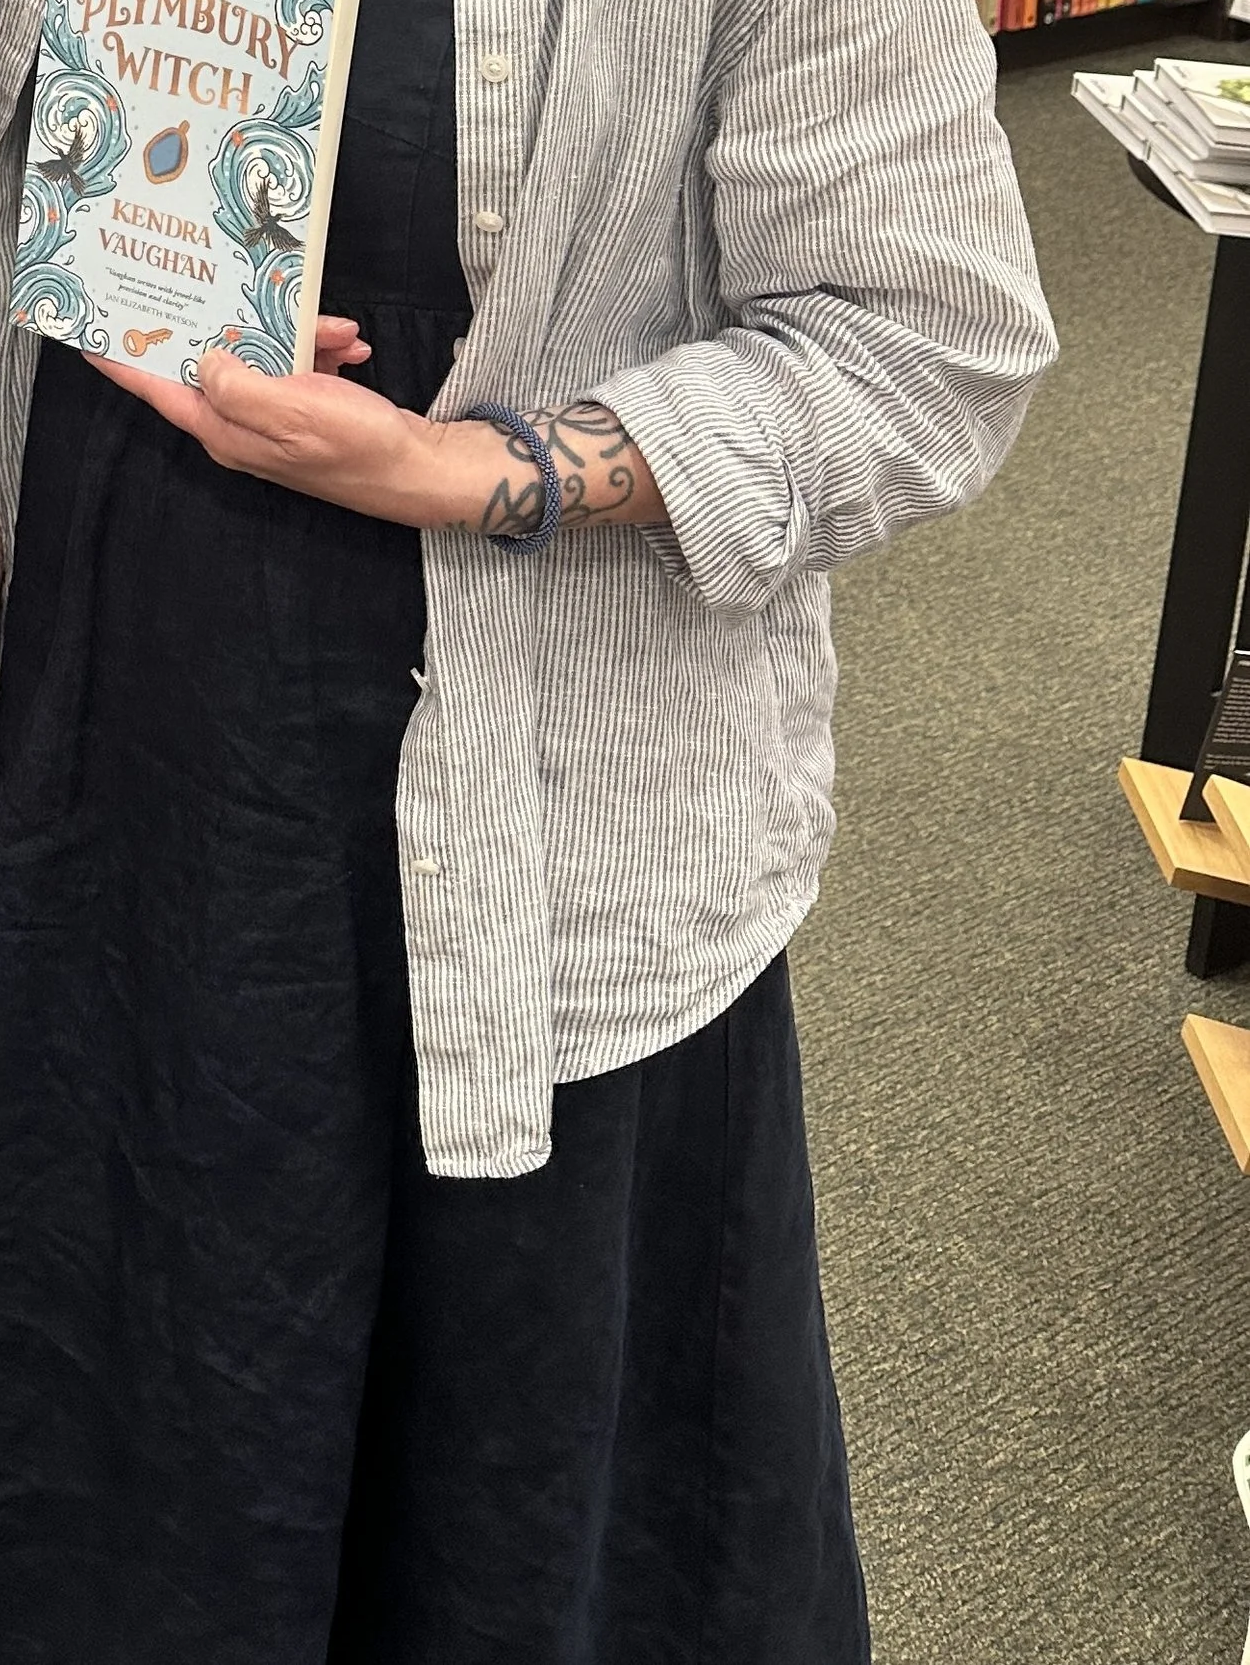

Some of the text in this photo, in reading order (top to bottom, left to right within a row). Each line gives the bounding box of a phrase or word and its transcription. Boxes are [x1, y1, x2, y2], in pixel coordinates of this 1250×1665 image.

[103, 30, 254, 115] WITCH
[112, 199, 213, 251] KENDRA
[98, 228, 218, 286] VAUGHAN
[105, 293, 199, 328] JAN ELIZABETH WATSON
